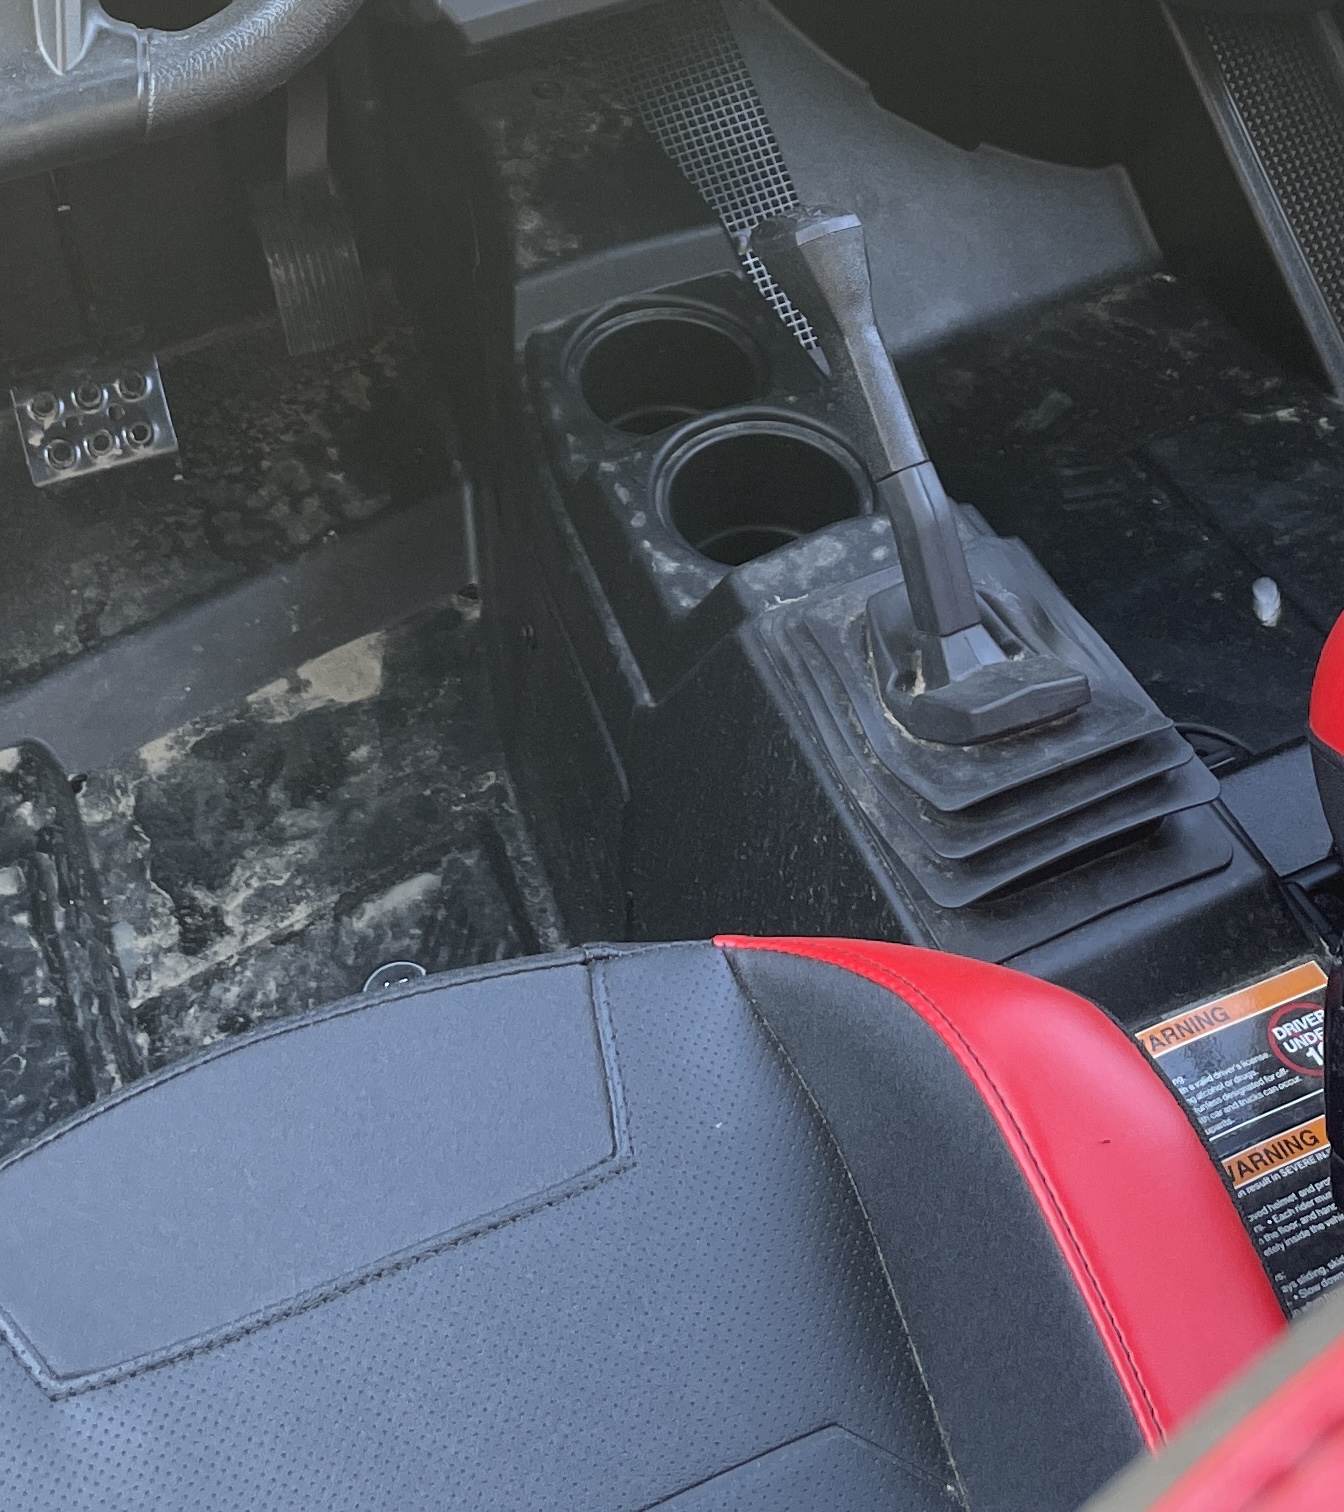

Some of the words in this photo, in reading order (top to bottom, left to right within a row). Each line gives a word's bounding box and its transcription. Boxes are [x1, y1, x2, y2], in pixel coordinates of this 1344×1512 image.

[1142, 1006, 1231, 1052] ARNING
[1195, 1073, 1214, 1088] valid
[1213, 1064, 1243, 1079] driver's
[1240, 1052, 1271, 1068] license.
[1196, 1082, 1225, 1100] alcohol
[1234, 1070, 1259, 1084] drugs.
[1210, 1109, 1223, 1119] car
[1223, 1102, 1239, 1114] and
[1238, 1092, 1264, 1107] trucks
[1263, 1085, 1279, 1096] can
[1278, 1076, 1302, 1090] occur.
[1222, 1078, 1265, 1100] designated
[1263, 1073, 1275, 1083] for
[1246, 1176, 1272, 1194] result
[1271, 1172, 1281, 1181] in
[1279, 1155, 1318, 1178] SEVERE
[1266, 1192, 1298, 1212] helmet
[1298, 1183, 1316, 1198] and
[1271, 1208, 1296, 1224] Each
[1295, 1199, 1315, 1213] rider
[1263, 1231, 1280, 1242] the
[1299, 1210, 1317, 1225] and
[1284, 1230, 1311, 1247] inside
[1309, 1223, 1325, 1234] the
[1296, 1266, 1329, 1285] sliding,
[1298, 1283, 1321, 1298] Slow
